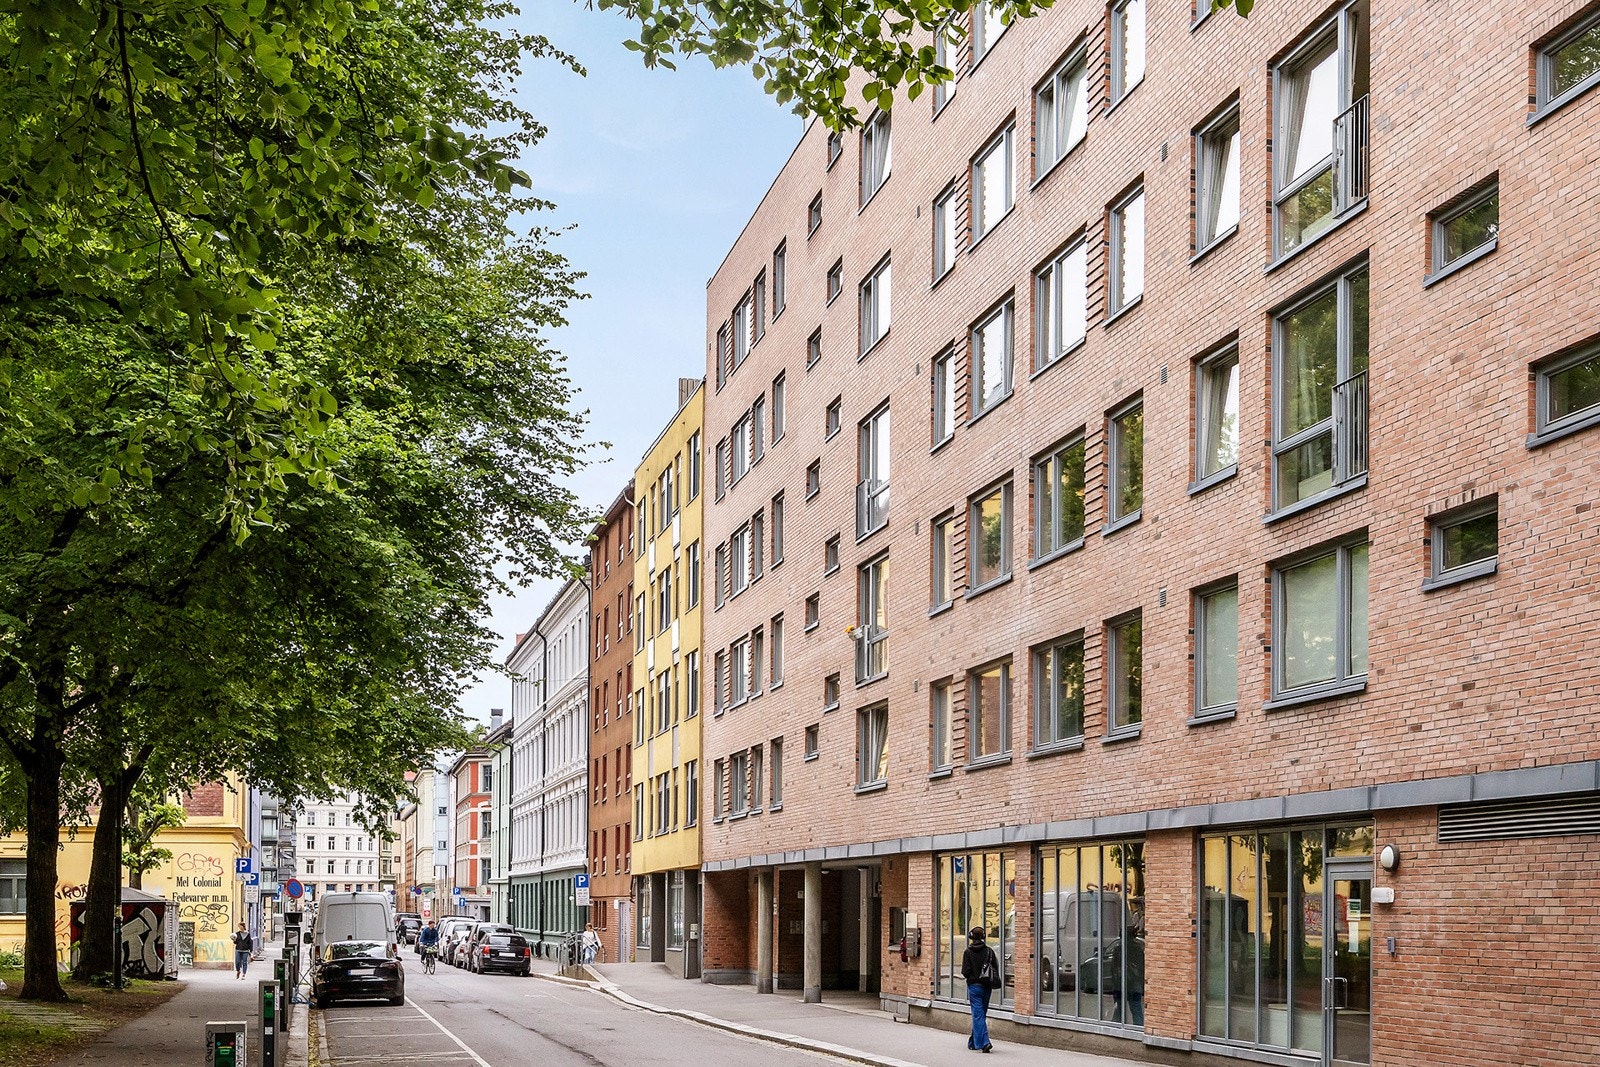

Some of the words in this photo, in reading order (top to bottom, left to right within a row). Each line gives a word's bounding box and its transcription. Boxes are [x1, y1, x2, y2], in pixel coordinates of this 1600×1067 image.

[240, 860, 248, 871] P
[176, 876, 189, 887] Mel
[193, 876, 222, 887] Colonial
[578, 875, 586, 887] P
[172, 892, 209, 902] Fedevarer
